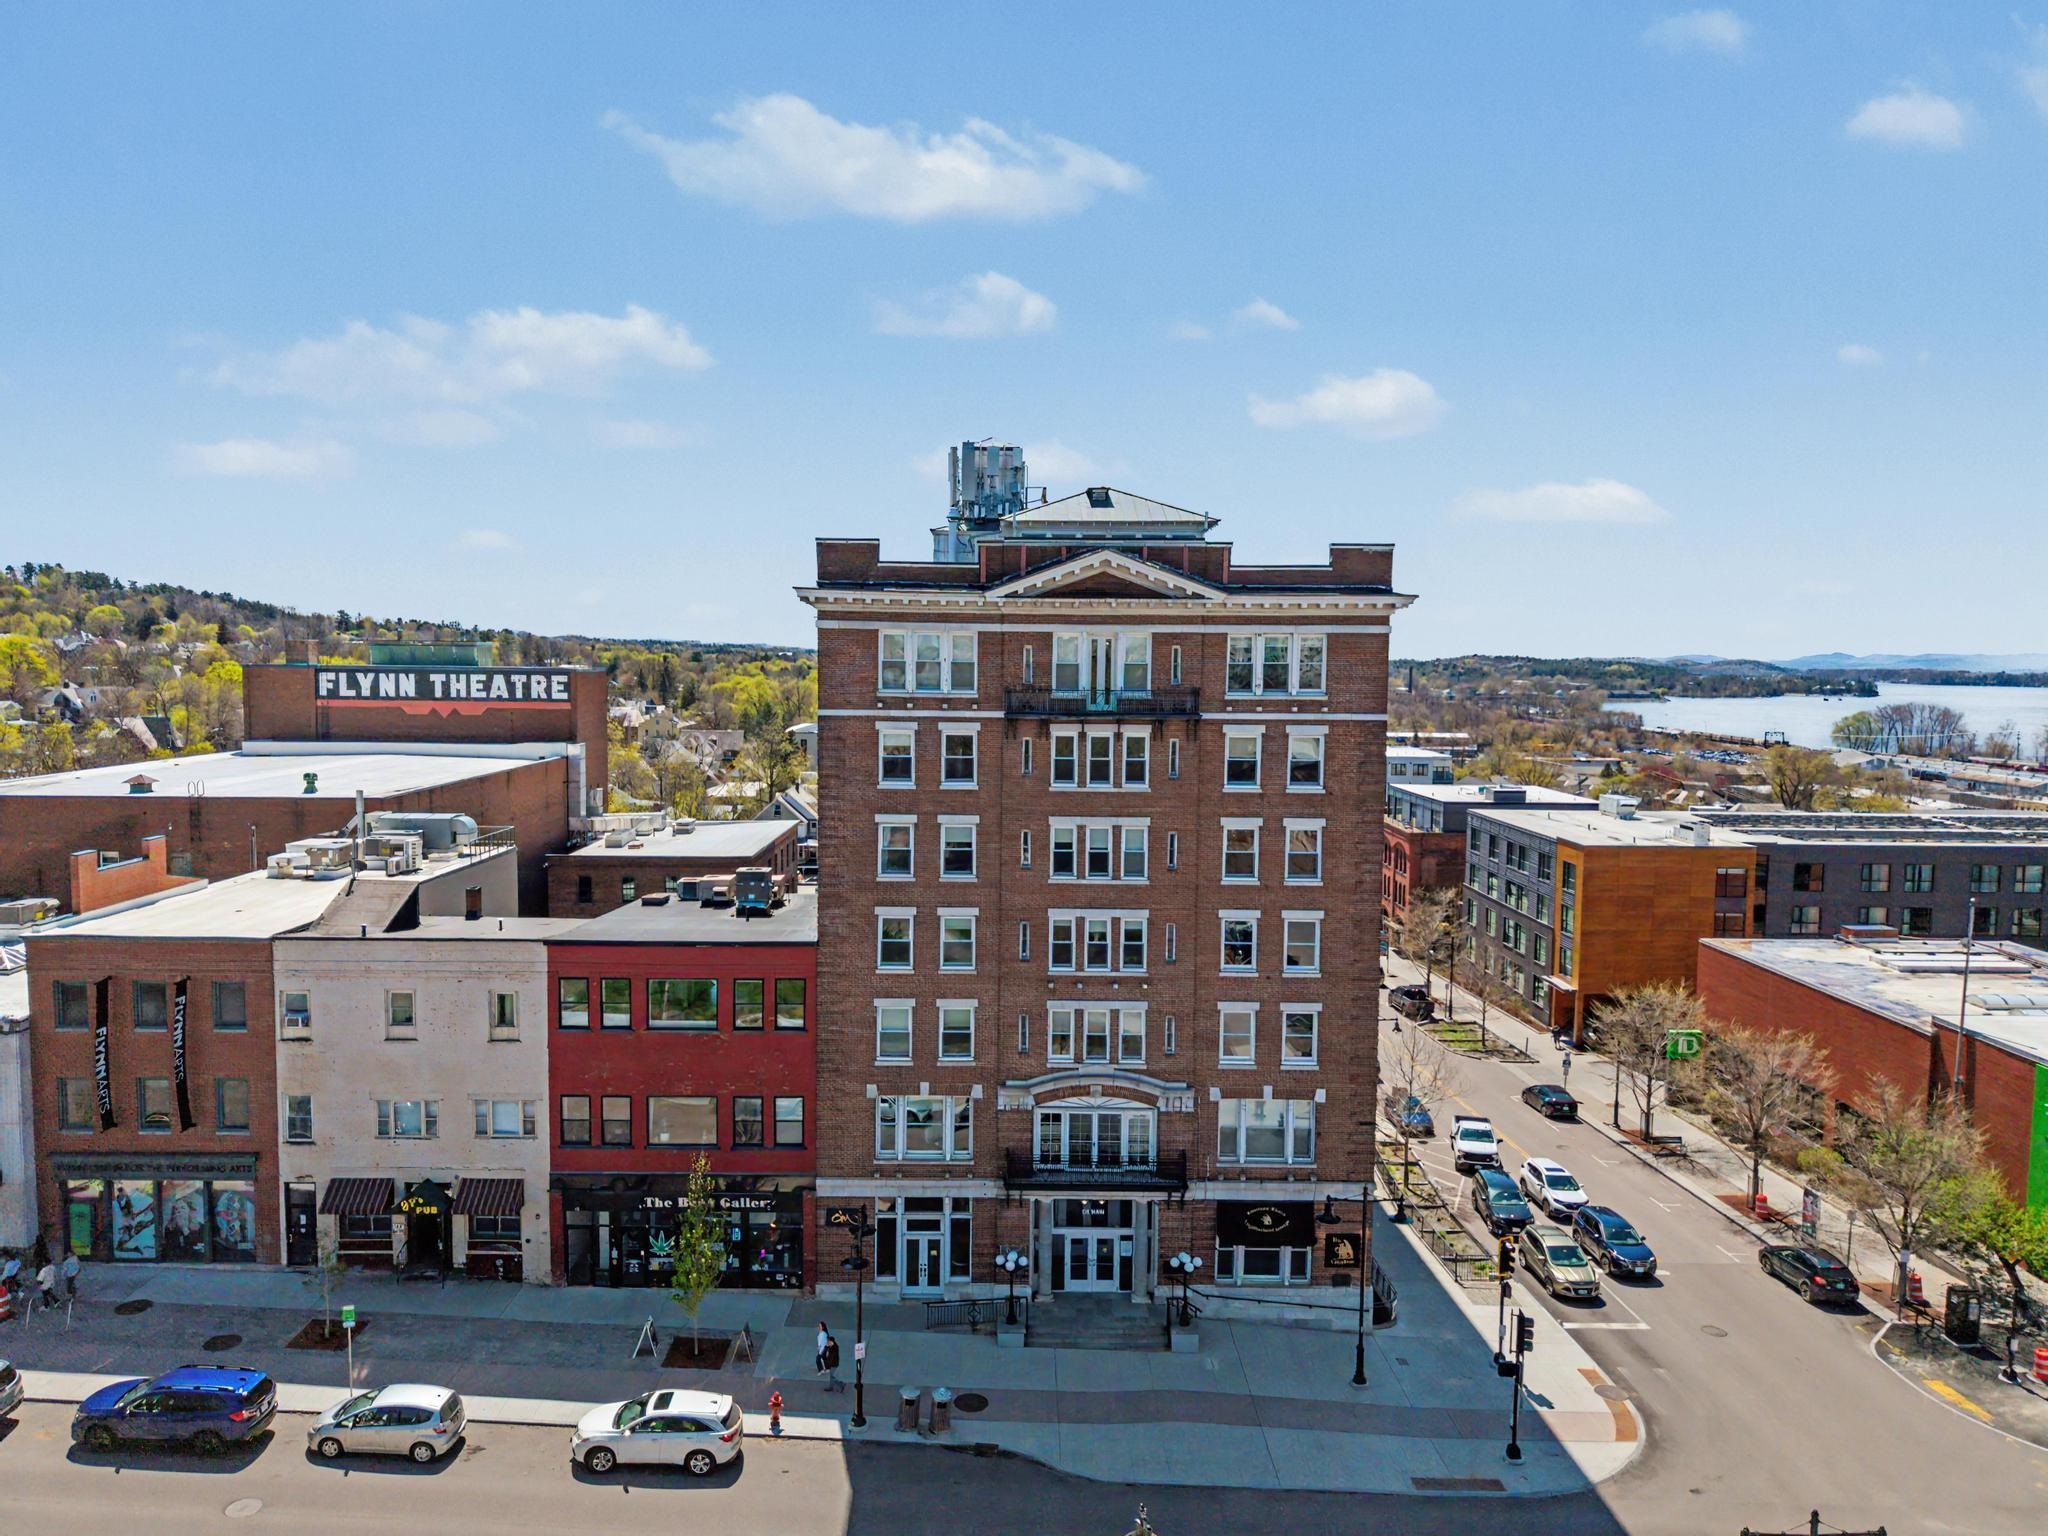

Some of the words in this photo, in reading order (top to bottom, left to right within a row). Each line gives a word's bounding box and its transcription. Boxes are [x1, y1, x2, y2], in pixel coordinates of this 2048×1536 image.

[319, 672, 416, 697] FLYNN
[429, 673, 569, 699] THEATRE
[1678, 1036, 1700, 1054] TD
[643, 1197, 673, 1208] The
[677, 1197, 716, 1208] Bn
[415, 1206, 438, 1215] PUB
